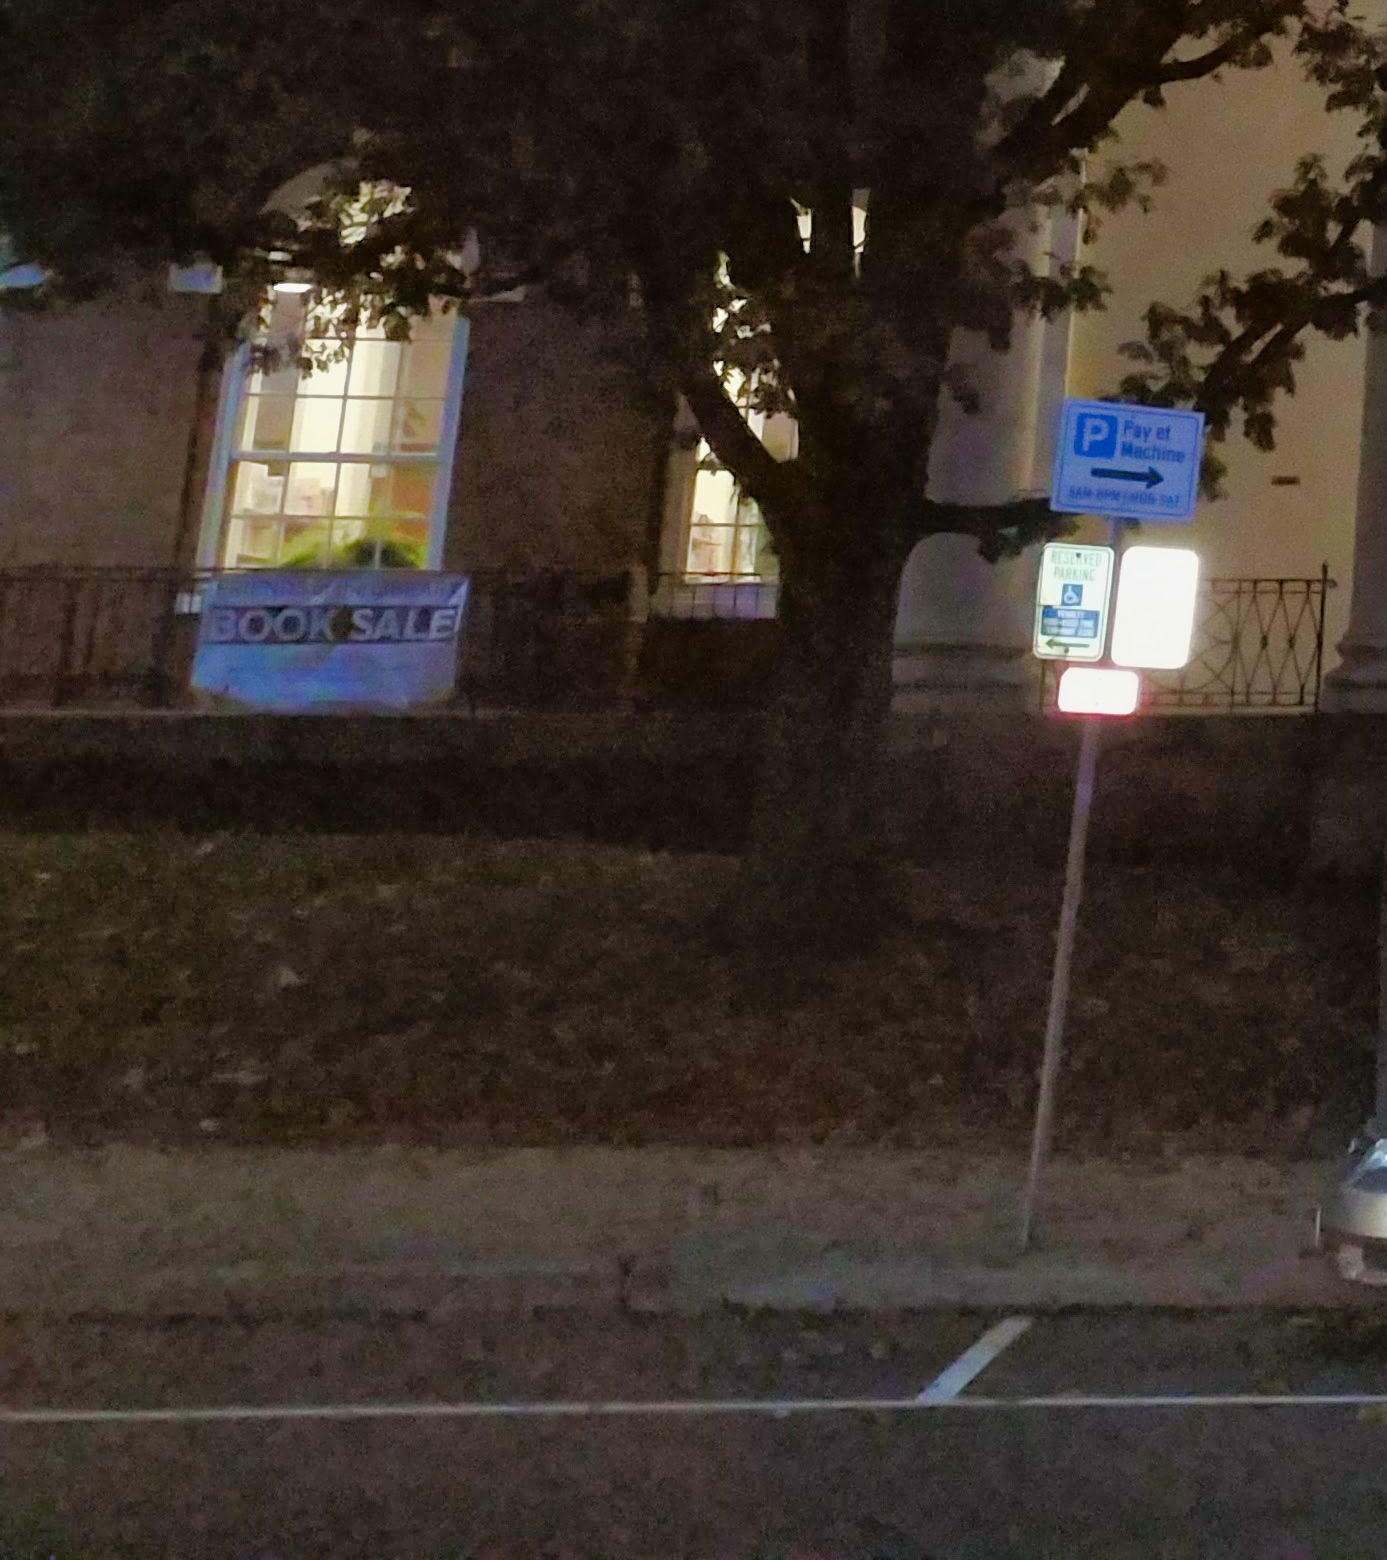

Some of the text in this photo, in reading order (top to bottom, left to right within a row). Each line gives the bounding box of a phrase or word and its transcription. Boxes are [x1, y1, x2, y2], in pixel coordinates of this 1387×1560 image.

[1082, 417, 1109, 452] P
[1123, 419, 1152, 443] Pay
[1121, 441, 1185, 463] Machine
[1051, 550, 1103, 567] RESERVED
[1054, 566, 1097, 582] PARKING
[210, 607, 458, 641] BOOK SALE
